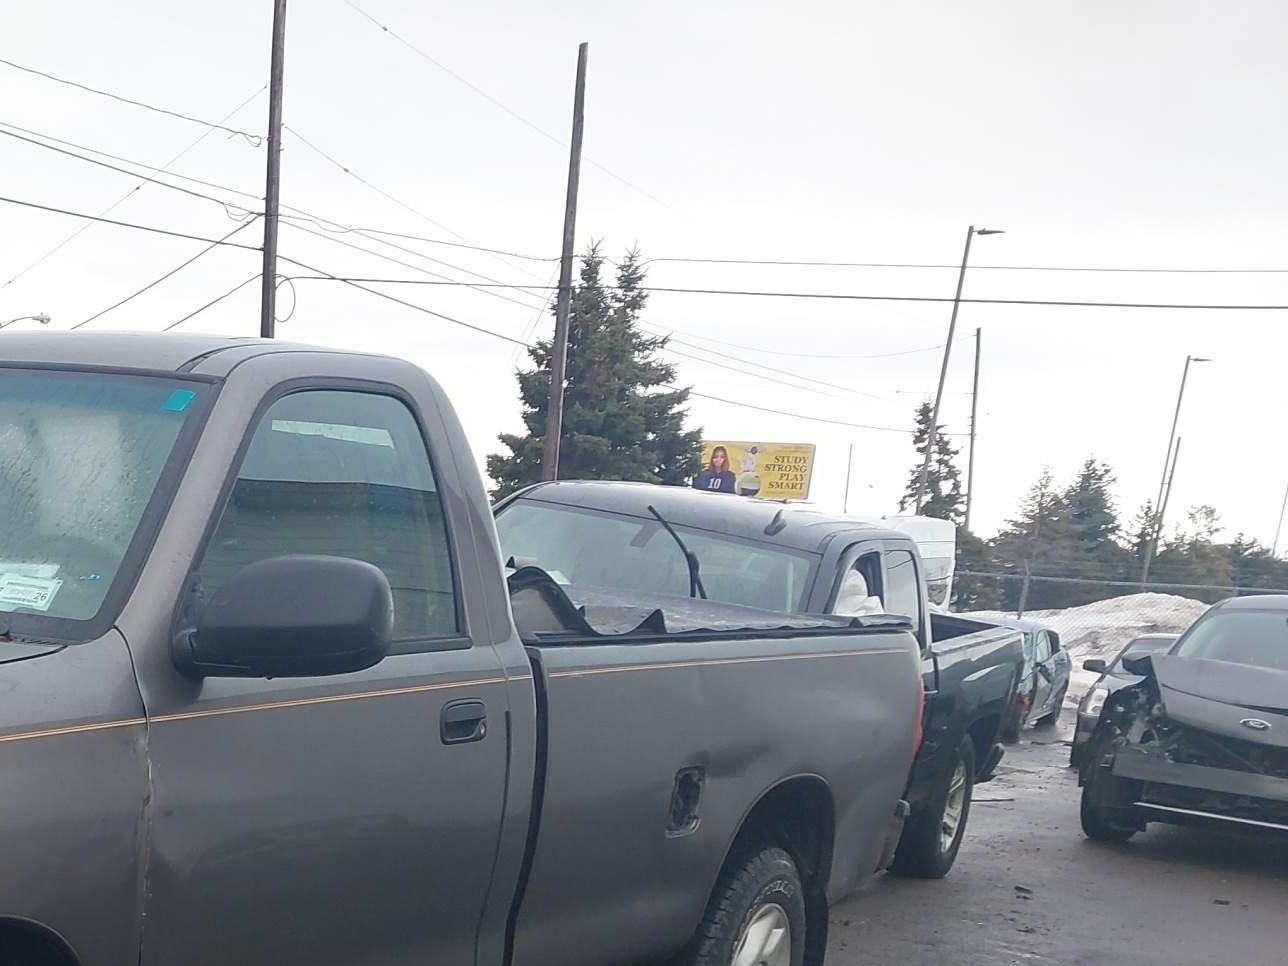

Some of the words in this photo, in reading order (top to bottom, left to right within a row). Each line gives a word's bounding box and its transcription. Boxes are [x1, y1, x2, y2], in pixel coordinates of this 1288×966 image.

[774, 455, 809, 464] STUDY
[764, 463, 808, 473] STRONG
[779, 473, 808, 481] PLAY
[708, 478, 722, 490] 10
[768, 481, 805, 490] SMART
[33, 591, 49, 602] 26
